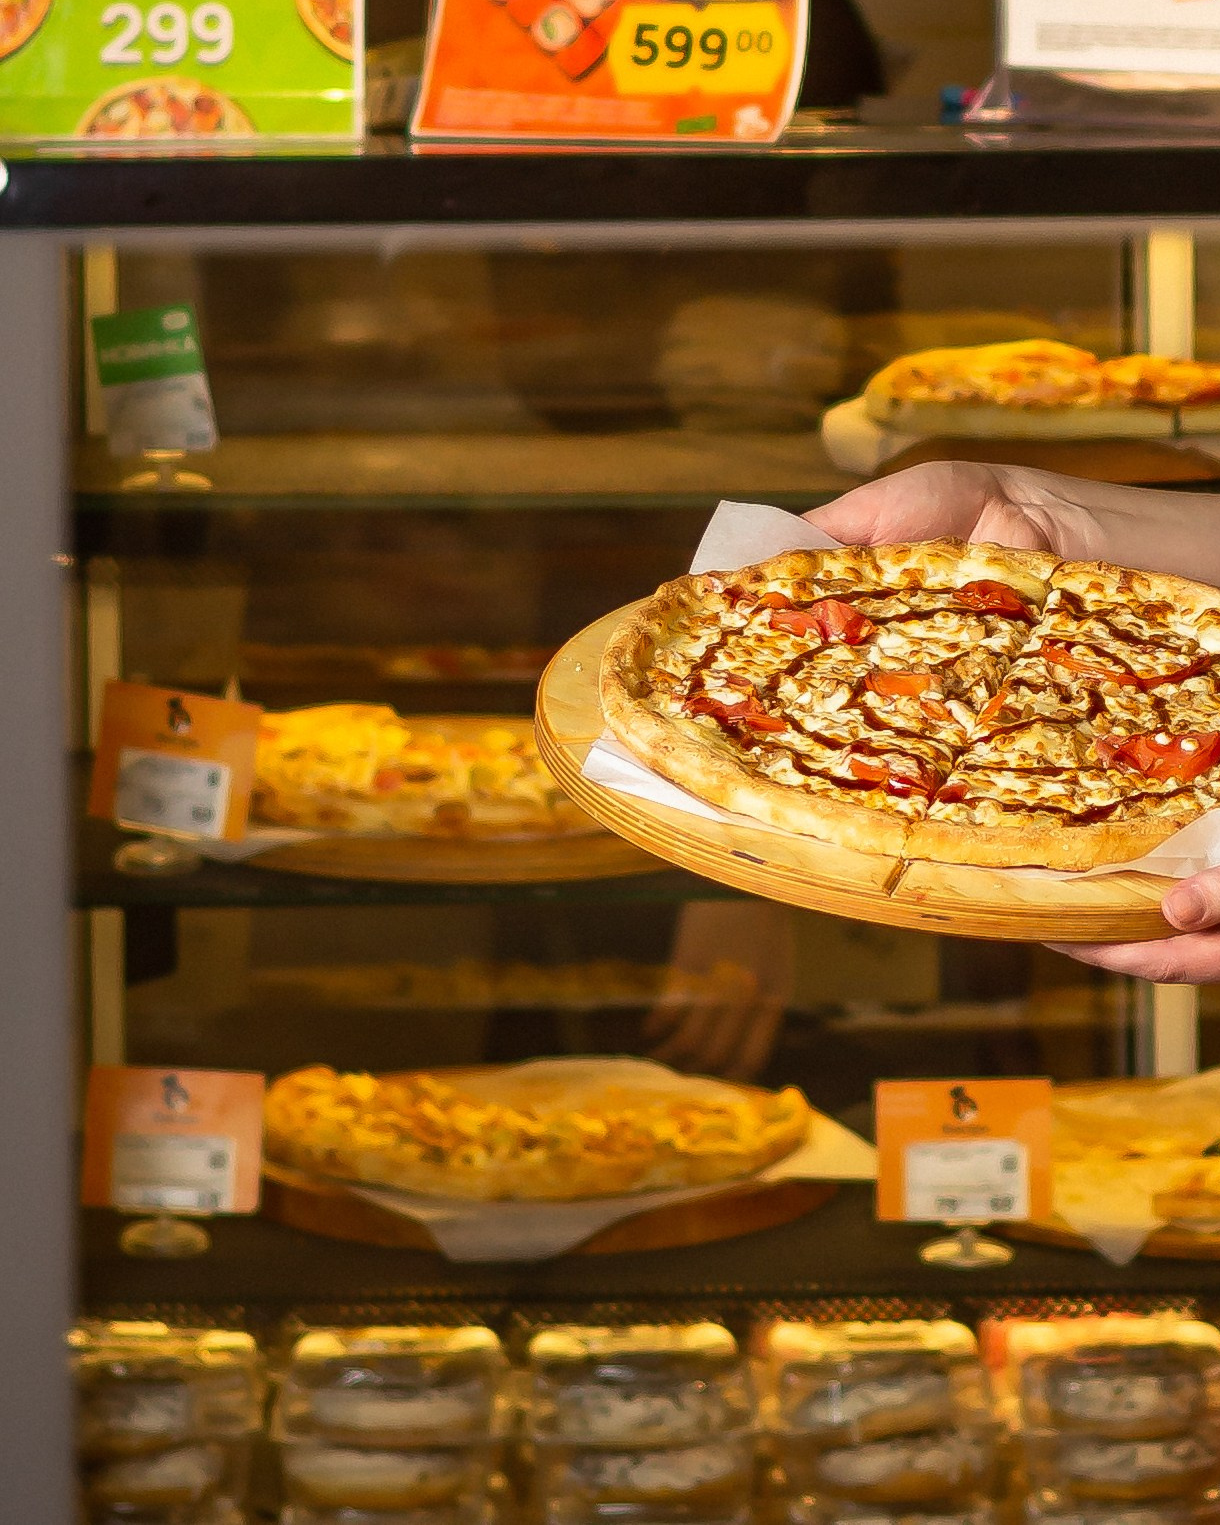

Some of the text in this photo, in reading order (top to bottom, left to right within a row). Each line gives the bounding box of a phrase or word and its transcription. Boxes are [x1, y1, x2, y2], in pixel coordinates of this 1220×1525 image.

[101, 1, 235, 66] 299
[630, 23, 773, 71] 599 00
